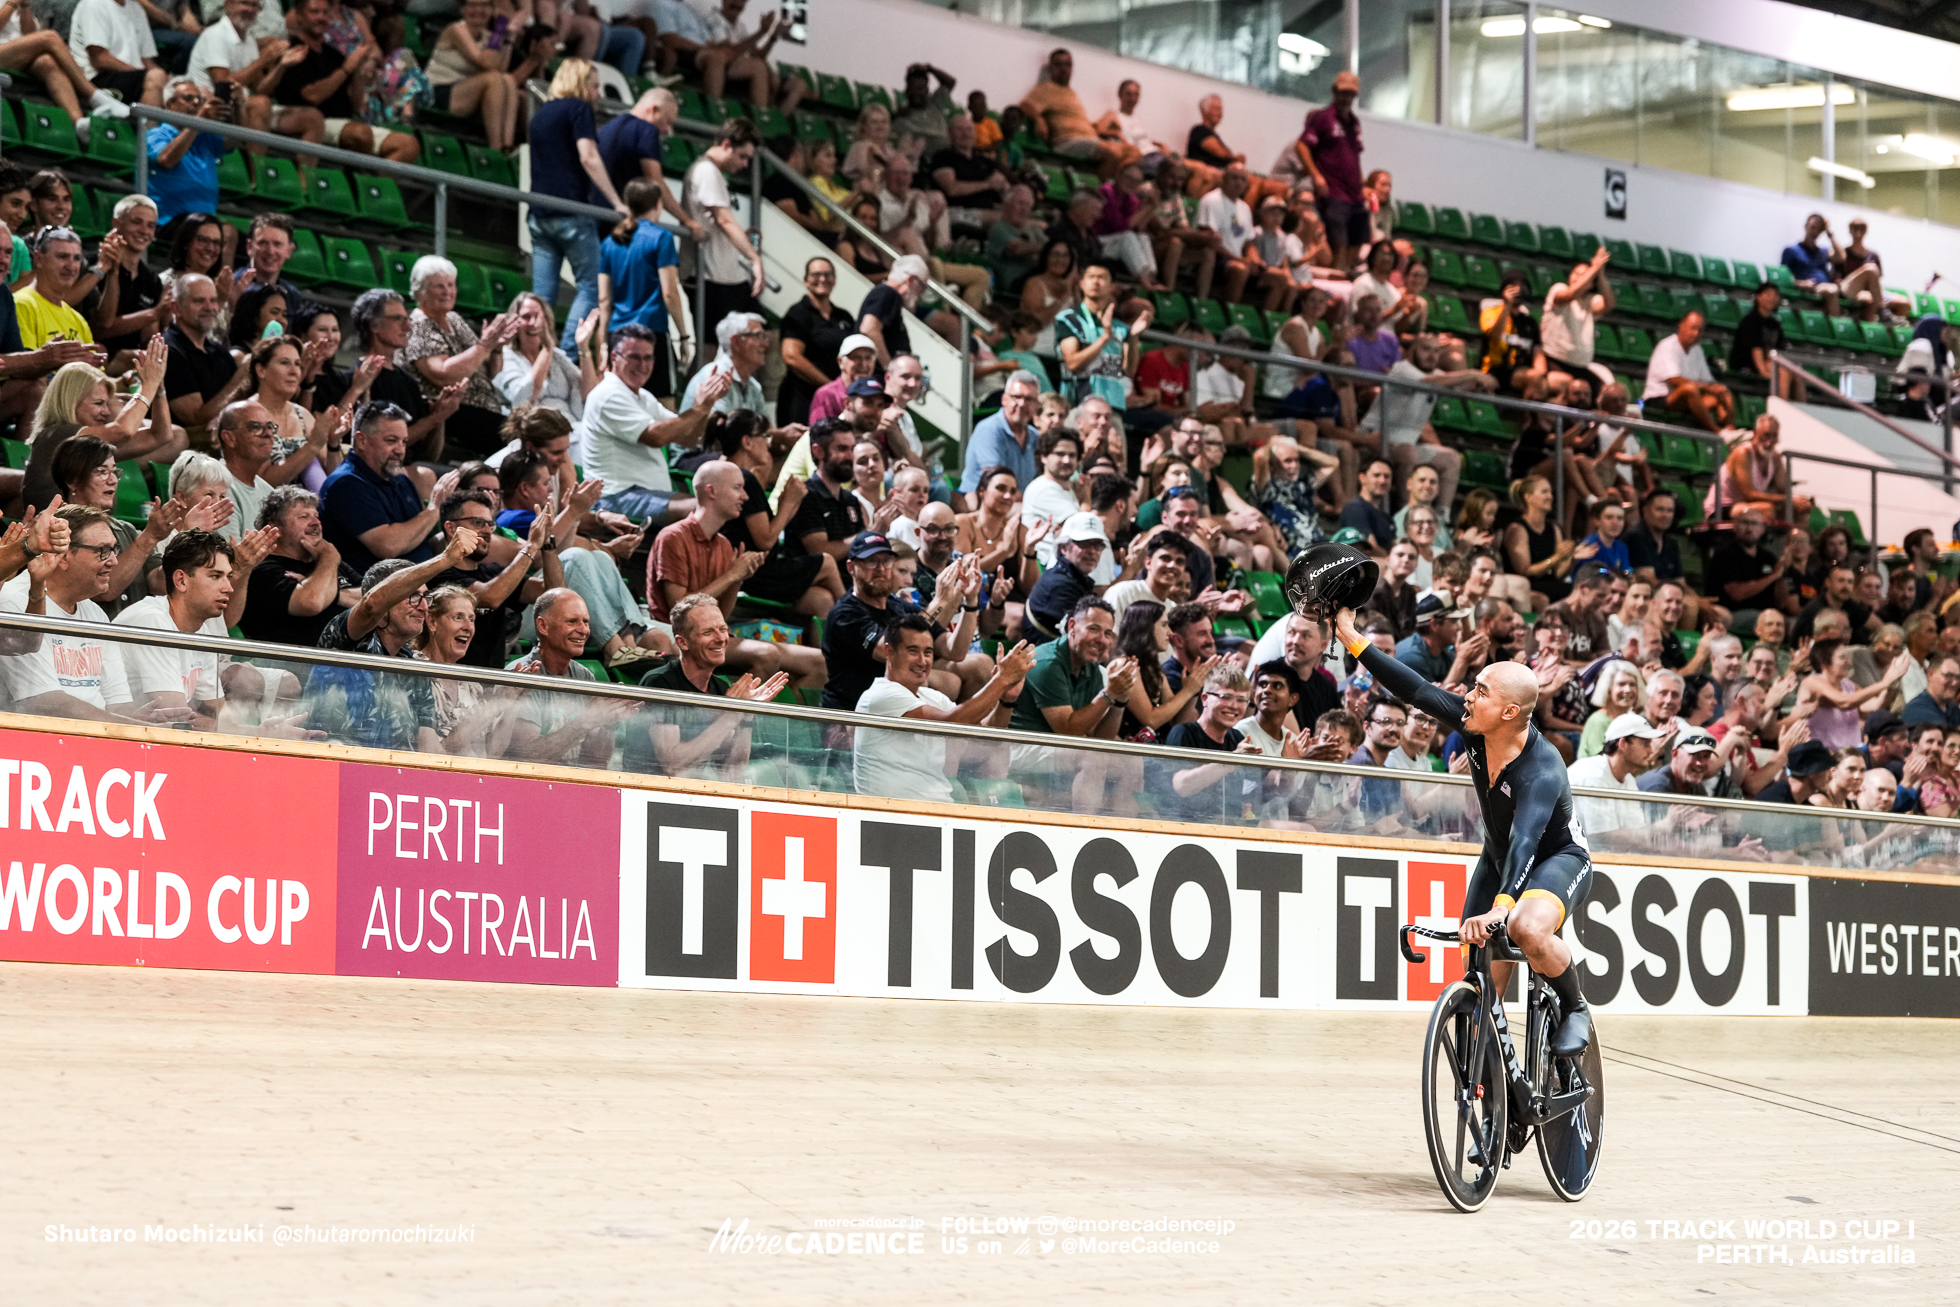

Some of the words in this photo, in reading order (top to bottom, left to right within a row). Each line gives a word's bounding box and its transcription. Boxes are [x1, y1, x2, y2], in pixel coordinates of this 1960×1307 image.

[1607, 174, 1625, 210] G
[1309, 556, 1354, 580] Kabuto
[0, 758, 168, 841] TRACK
[367, 791, 505, 866] PERTH
[0, 860, 192, 940] WORLD
[207, 874, 310, 946] CUP
[361, 885, 598, 961] AUSTRALIA
[860, 819, 1301, 999] TISSOT
[1504, 871, 1797, 1007] SSOT
[1826, 921, 1960, 978] WESTER
